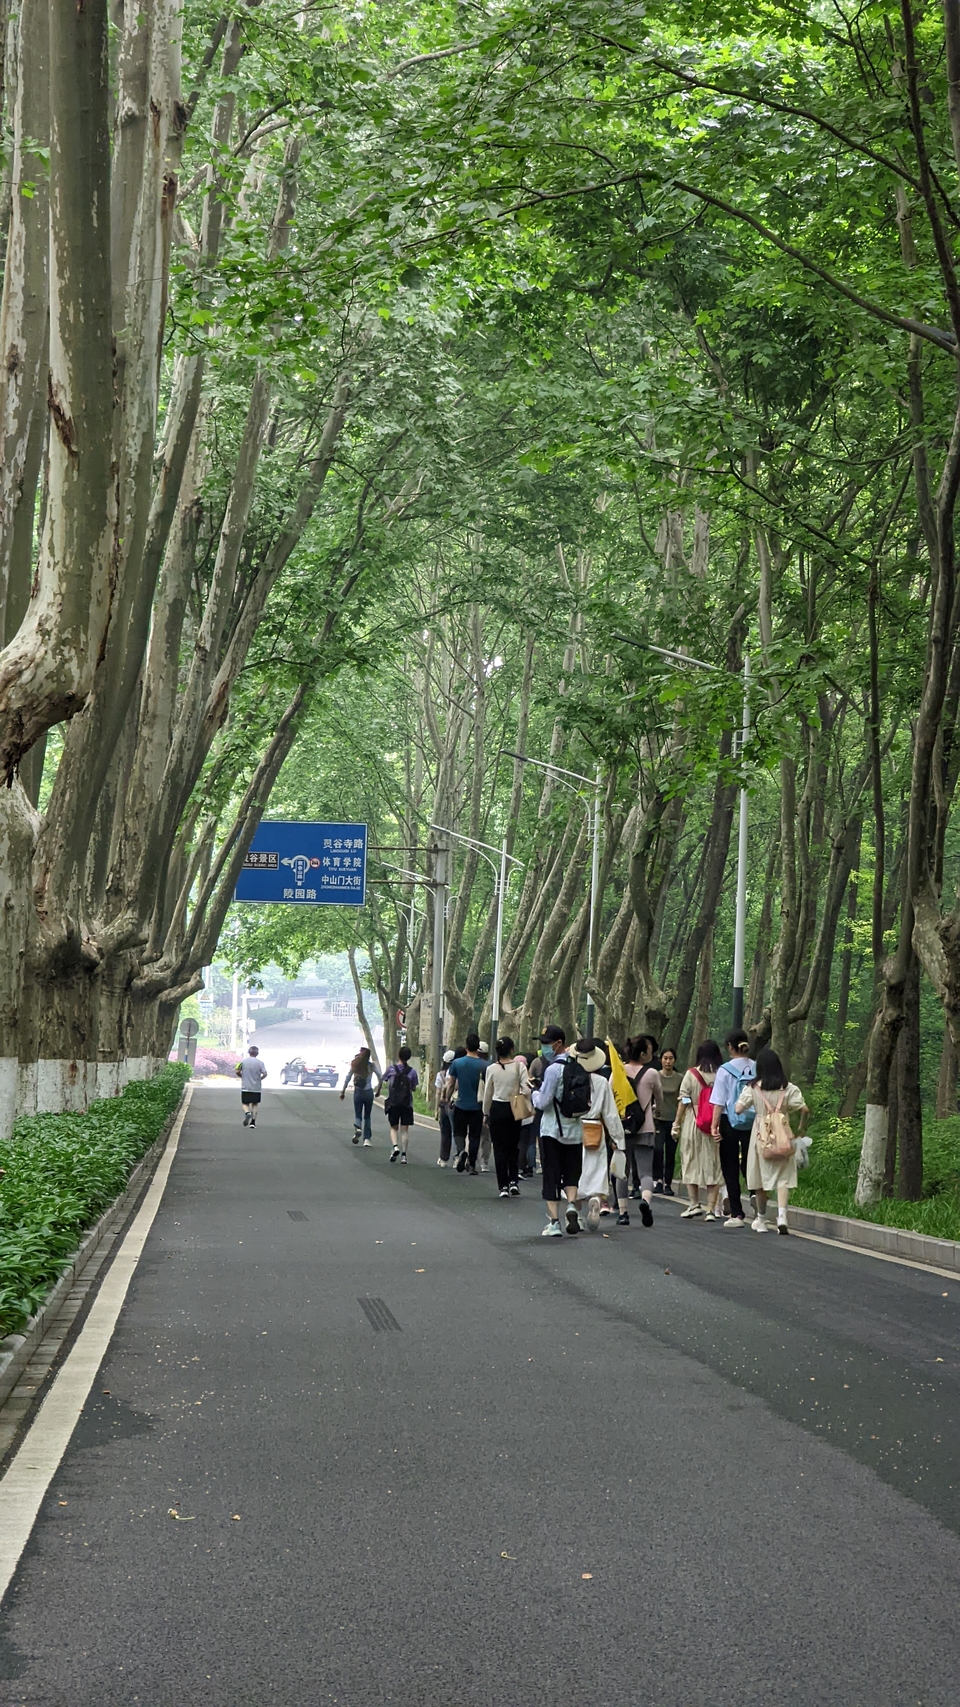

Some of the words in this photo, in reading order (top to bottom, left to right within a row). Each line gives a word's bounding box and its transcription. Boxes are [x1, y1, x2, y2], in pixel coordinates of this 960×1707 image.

[323, 838, 364, 849] 灵谷寺路
[322, 856, 362, 867] 体育学院
[322, 874, 362, 885] 中山门大街
[283, 888, 317, 899] 陵园路
